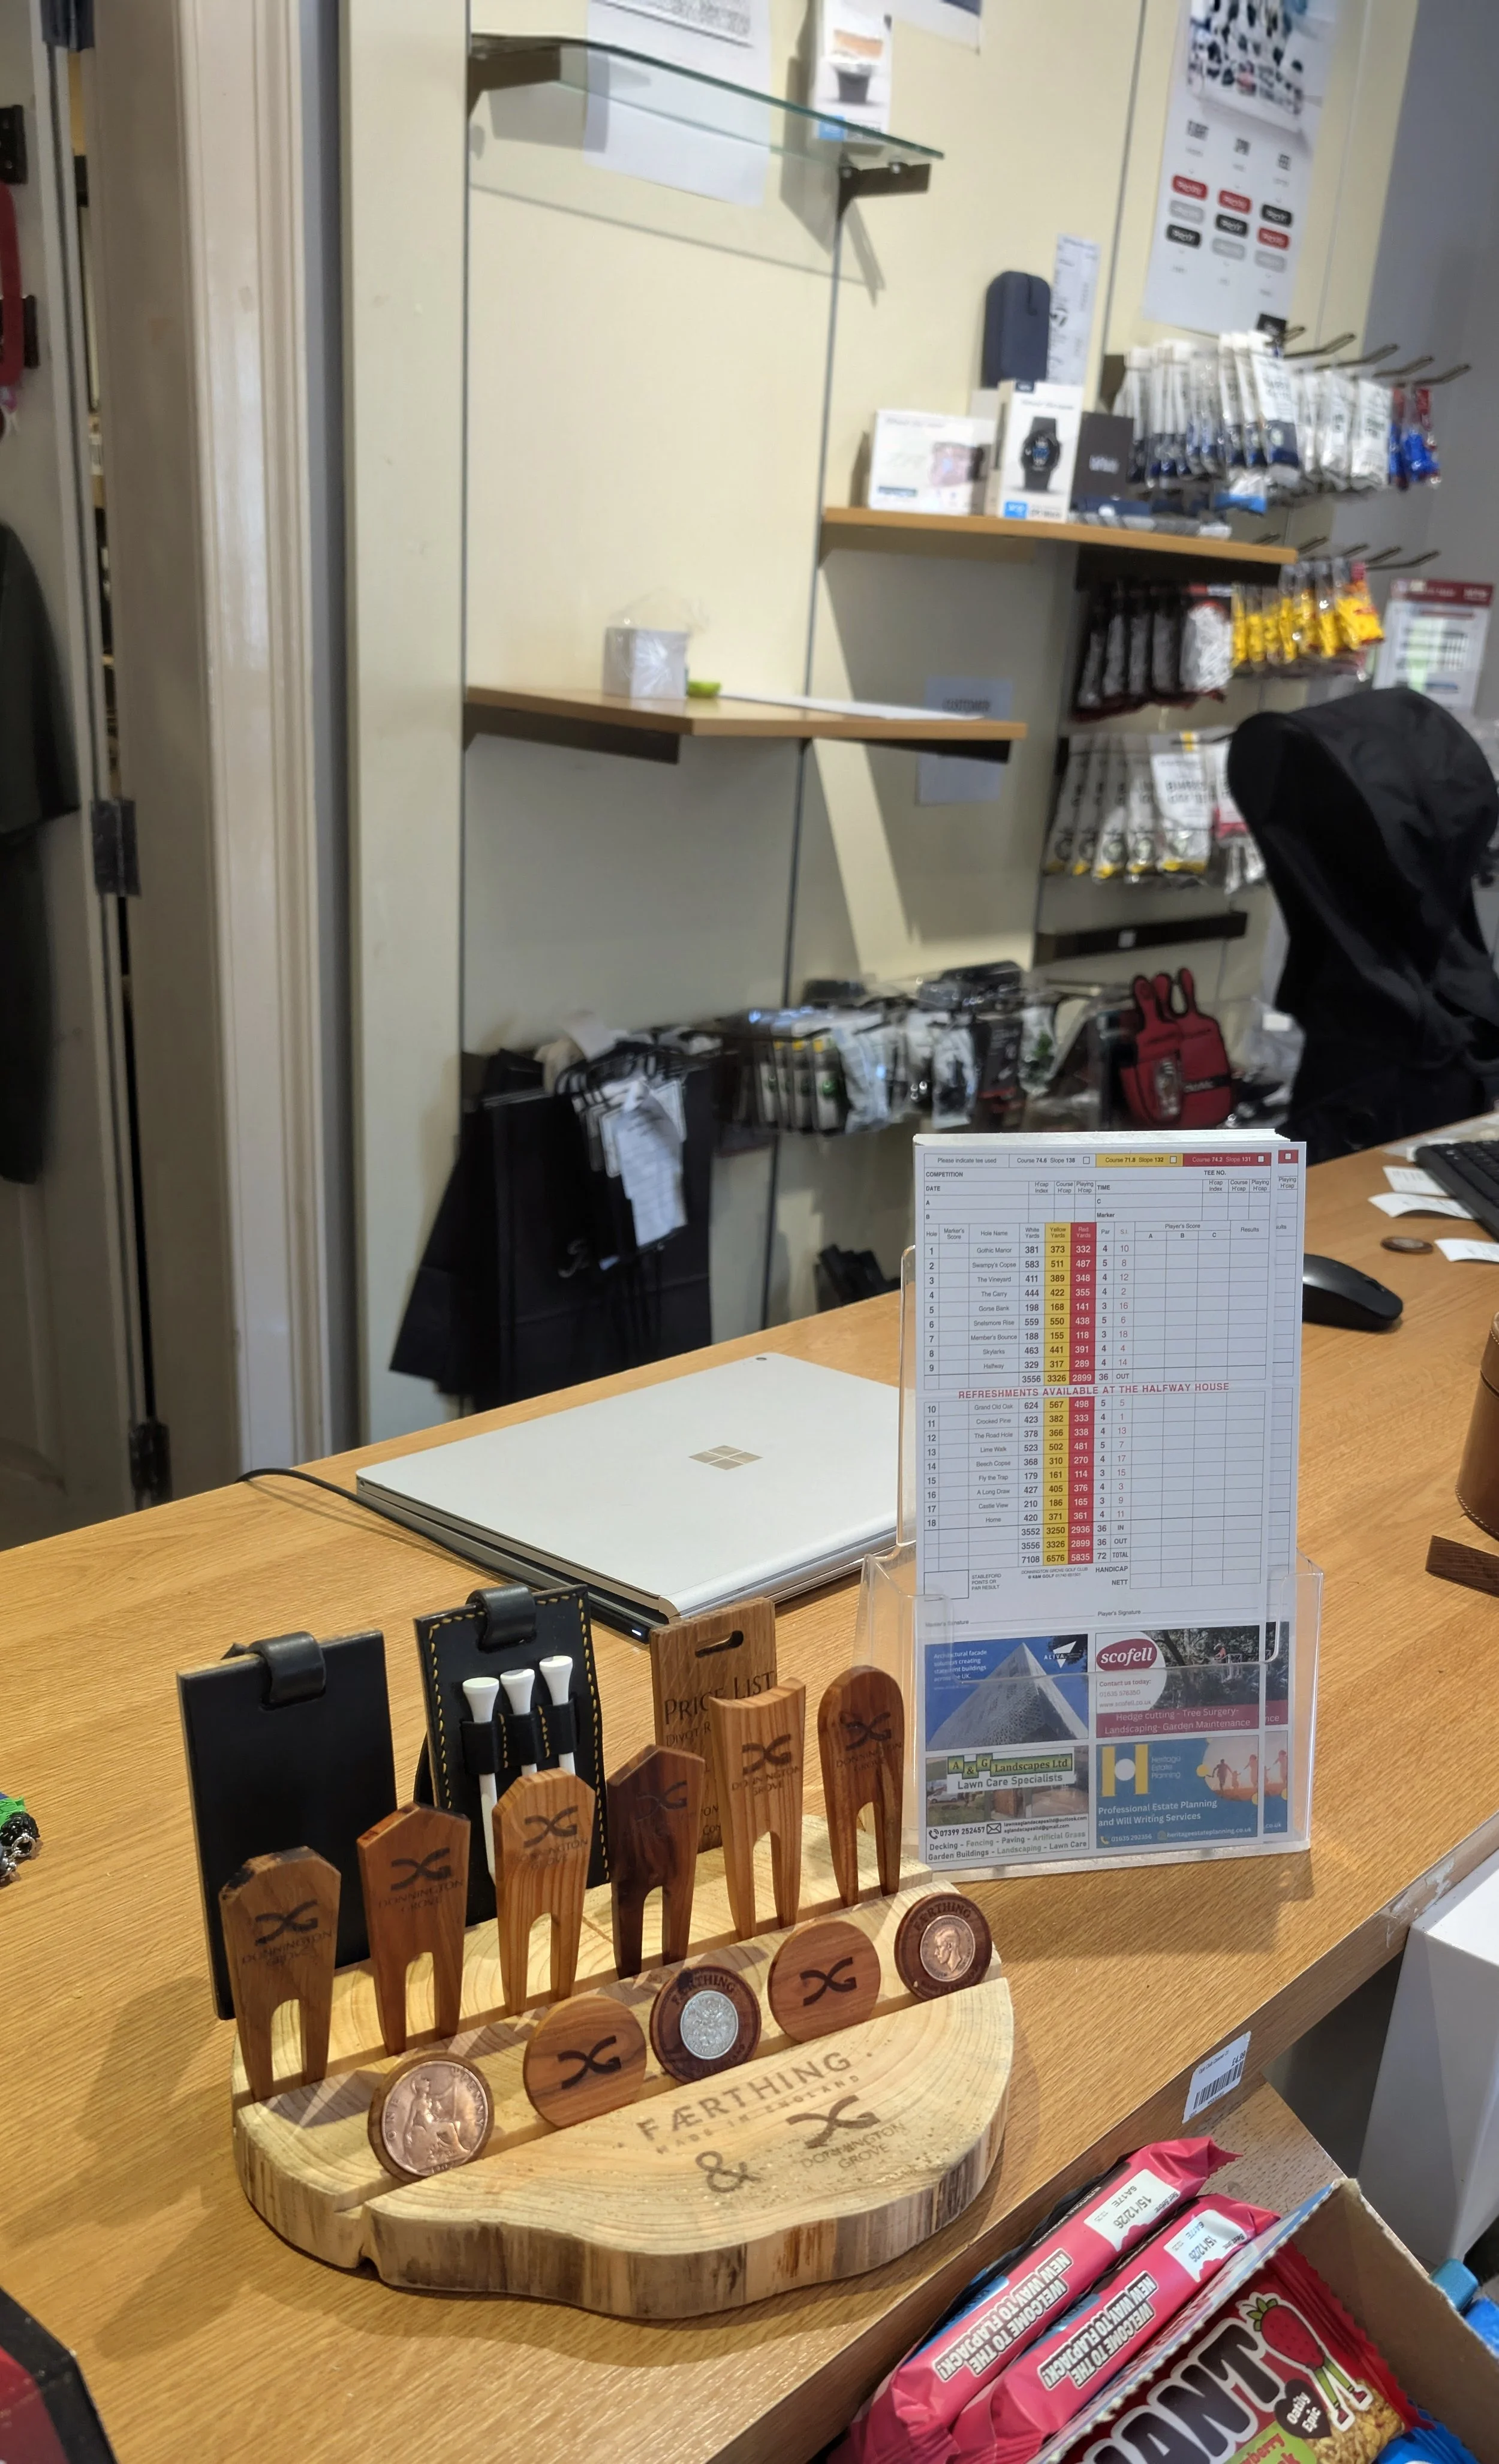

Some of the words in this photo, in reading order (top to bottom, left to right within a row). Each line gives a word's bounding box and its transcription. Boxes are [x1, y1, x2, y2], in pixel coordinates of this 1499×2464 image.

[959, 1388, 1039, 1399] REFRESHMENTS
[1043, 1387, 1098, 1396] AVAILABLE
[1142, 1384, 1190, 1392] HALFWAY
[1195, 1383, 1229, 1391] HOUSE
[1101, 1648, 1152, 1665] scofell
[735, 1671, 775, 1699] LIST
[1116, 1713, 1142, 1722] Hedge
[1145, 1711, 1174, 1721] cutting
[1196, 1719, 1250, 1729] Maintenance
[667, 1728, 699, 1745] DIVOT
[982, 1759, 988, 1767] G
[995, 1761, 1050, 1772] Landscapes
[1053, 1759, 1067, 1768] Ltd
[958, 1781, 983, 1790] Lawn
[1012, 1774, 1062, 1785] Specialists
[1098, 1804, 1149, 1815] Professional
[1181, 1800, 1217, 1809] Planning
[1116, 1817, 1131, 1825] Will
[1134, 1815, 1164, 1824] Writing
[930, 1842, 958, 1850] Decking
[997, 1845, 1041, 1854] Landscaping
[1229, 2050, 1246, 2066] £4.99
[636, 2052, 851, 2142] FÆRTHING
[765, 2075, 859, 2113] ENGLAND
[802, 2120, 911, 2168] DONNINGTON
[839, 2143, 890, 2168] GROVE
[695, 2150, 764, 2194] &
[1113, 2195, 1152, 2230] 15/12/26
[1185, 2221, 1205, 2239] 6A17E
[1187, 2235, 1217, 2263] 15/12/26
[1039, 2254, 1070, 2282] NEW
[1014, 2278, 1044, 2306] WAY
[1127, 2276, 1157, 2303] NEW
[998, 2300, 1018, 2320] TO
[1006, 2279, 1066, 2336] WELCOME
[1107, 2296, 1134, 2324] WAY
[1094, 2315, 1113, 2336] TO
[1102, 2303, 1153, 2354] WELCOME
[935, 2314, 1003, 2379] FLAPJACK!
[991, 2329, 1012, 2352] TO
[968, 2344, 997, 2373] THE
[1041, 2328, 1100, 2385] FLAPJACK!
[1089, 2345, 1108, 2366] TO
[1069, 2357, 1095, 2385] THE
[1286, 2391, 1311, 2424] Oatily
[1302, 2407, 1321, 2433] Epic
